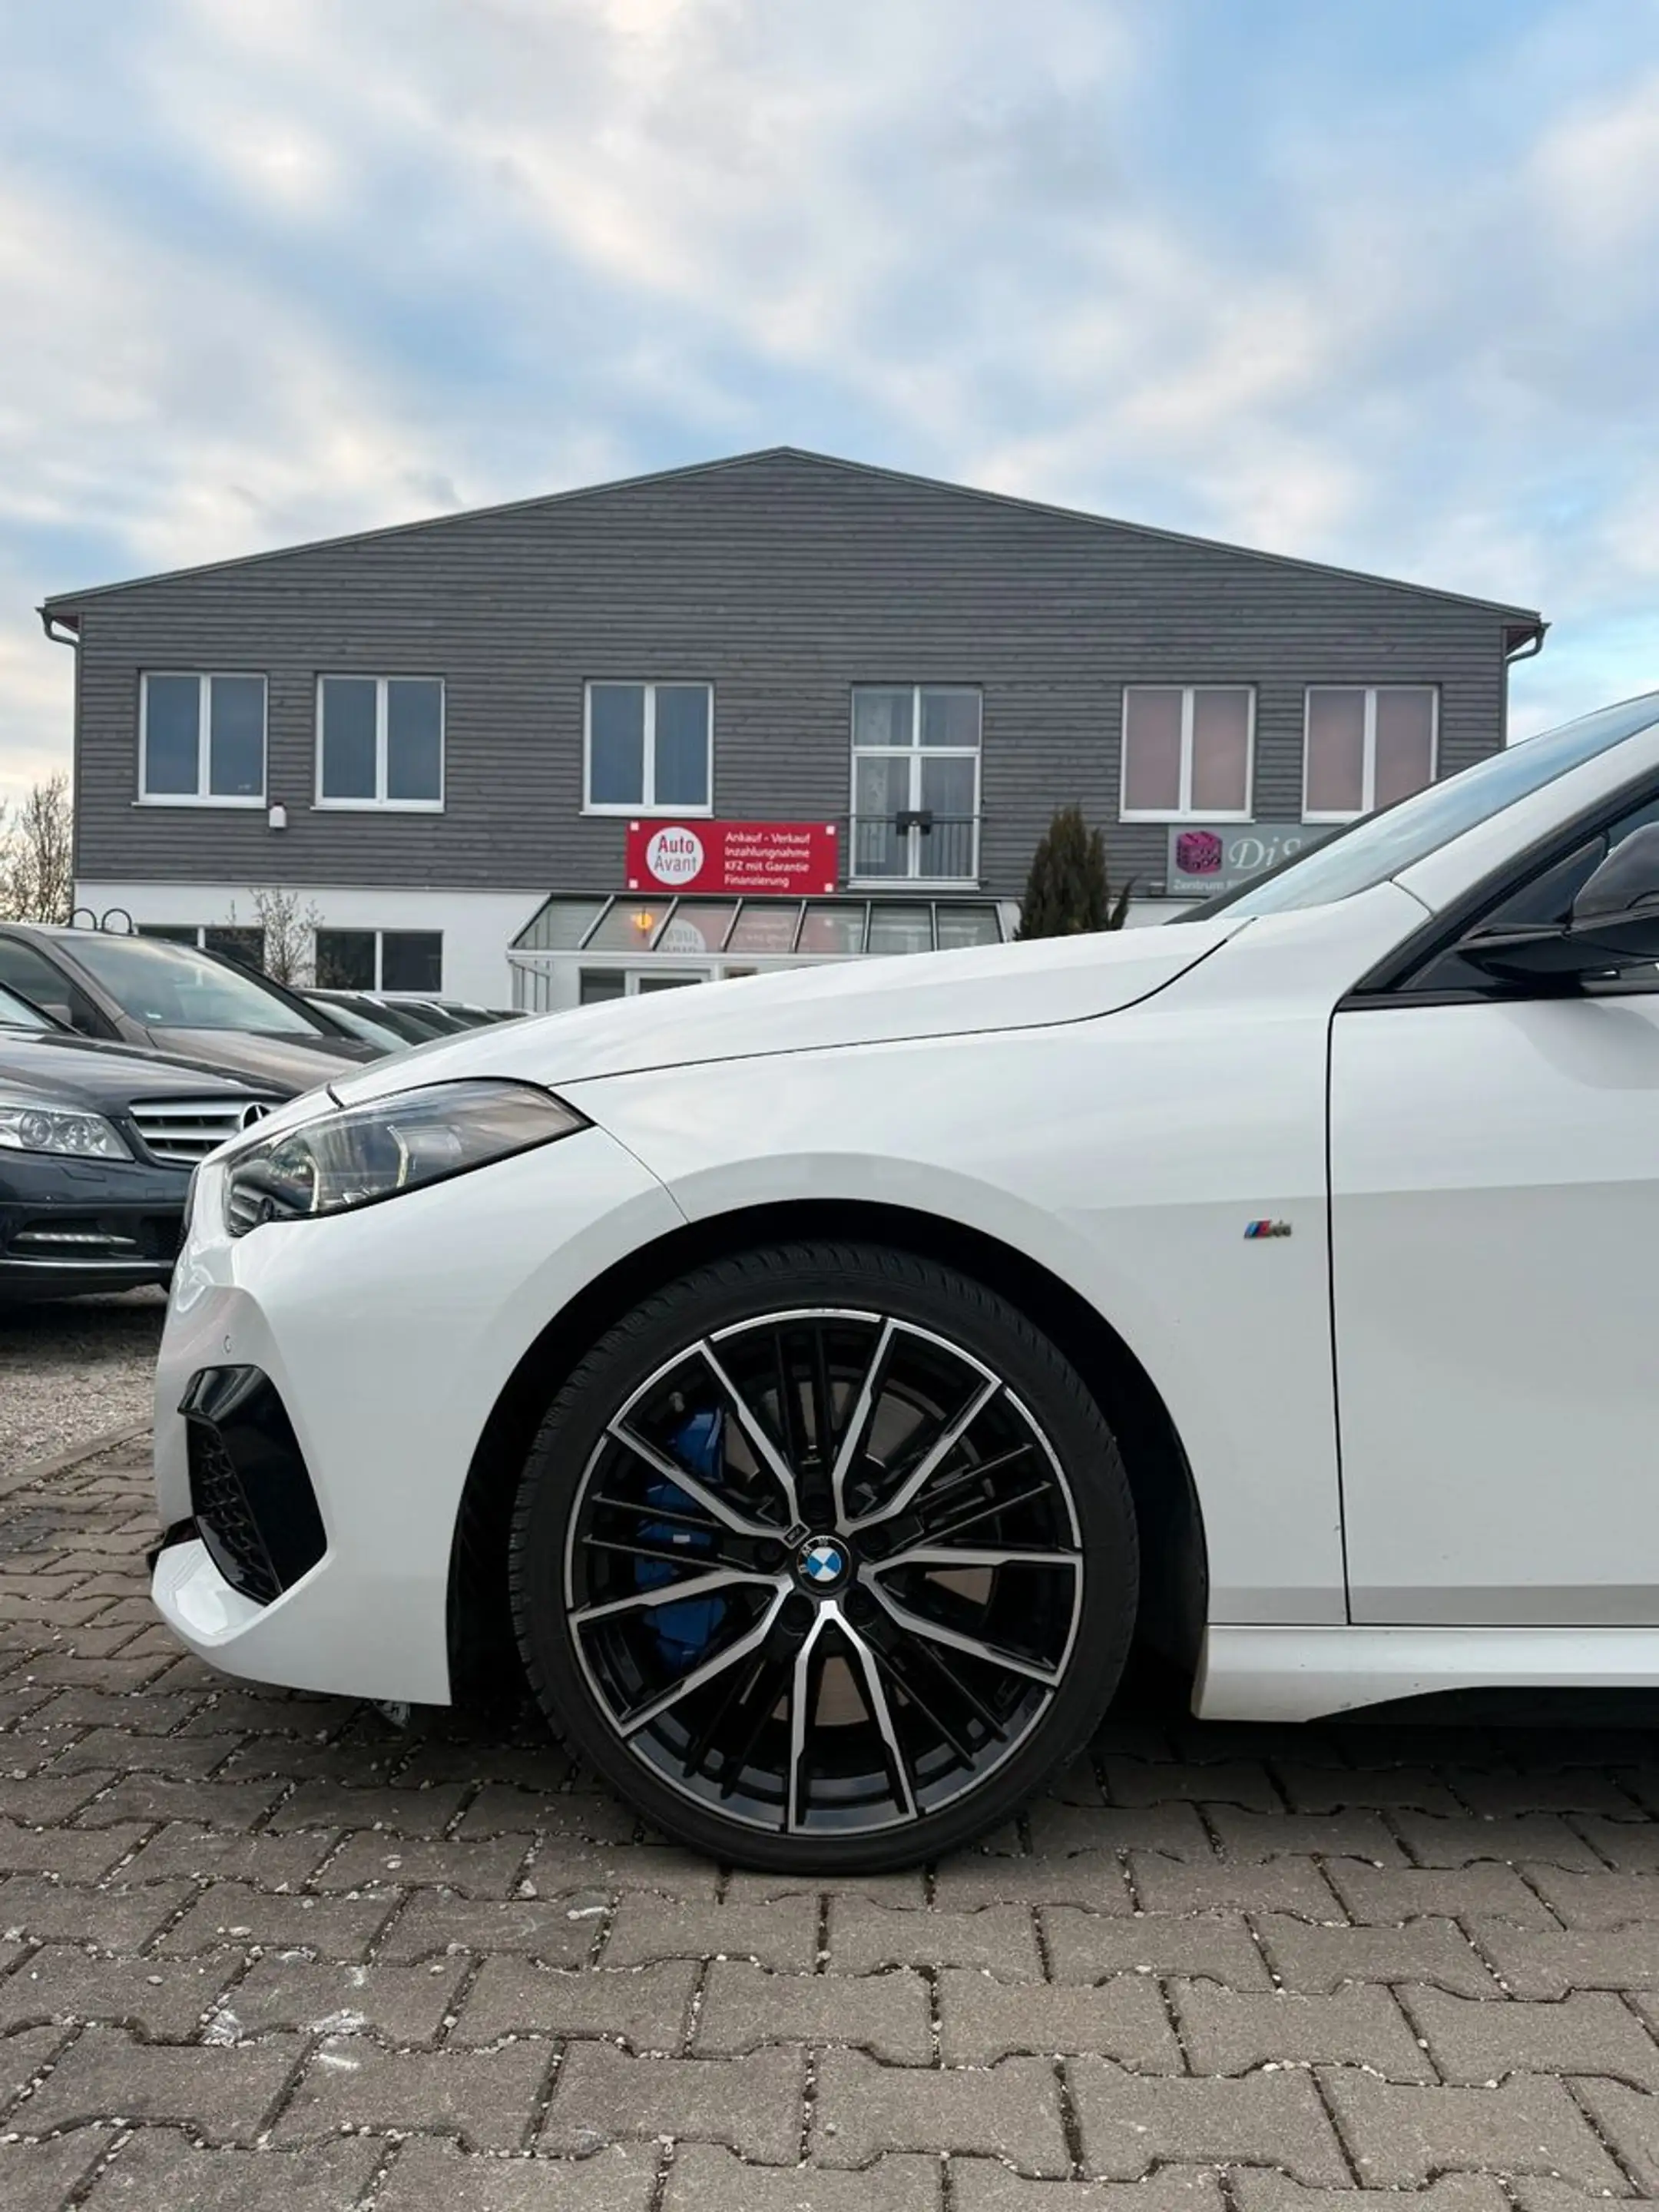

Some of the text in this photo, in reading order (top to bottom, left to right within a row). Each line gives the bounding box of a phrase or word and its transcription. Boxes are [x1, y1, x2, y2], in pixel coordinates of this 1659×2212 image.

[657, 835, 694, 854] Auto
[725, 832, 763, 843] Ankauf
[770, 833, 811, 844] Verkauf
[654, 855, 697, 873] Avant
[724, 861, 810, 873] KFZ mit Garantie
[724, 874, 790, 889] Finanzierung
